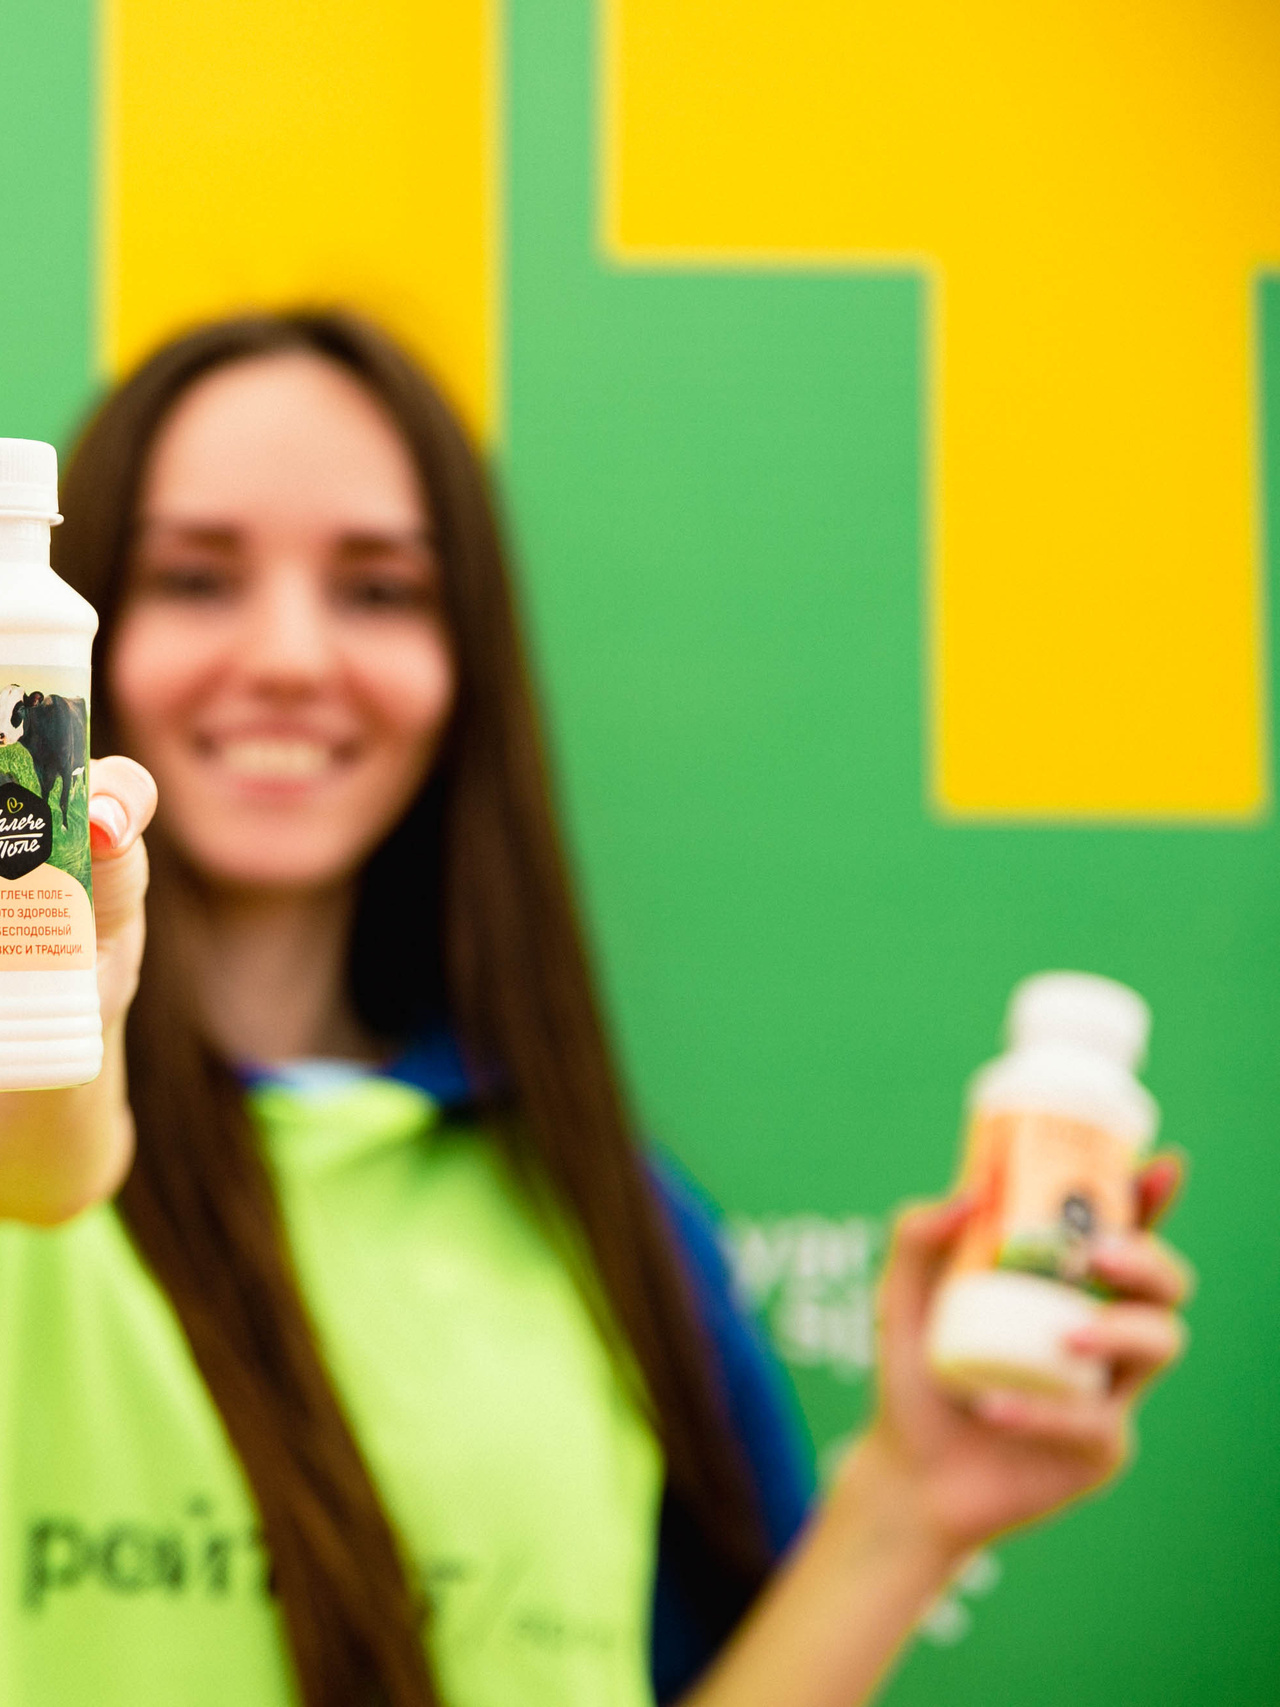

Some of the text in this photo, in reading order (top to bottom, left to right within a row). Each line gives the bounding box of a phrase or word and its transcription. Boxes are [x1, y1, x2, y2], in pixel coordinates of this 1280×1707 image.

[37, 890, 63, 900] ПОЛЕ
[17, 908, 71, 919] ЗДОРОВЬЕ,
[25, 945, 33, 954] И
